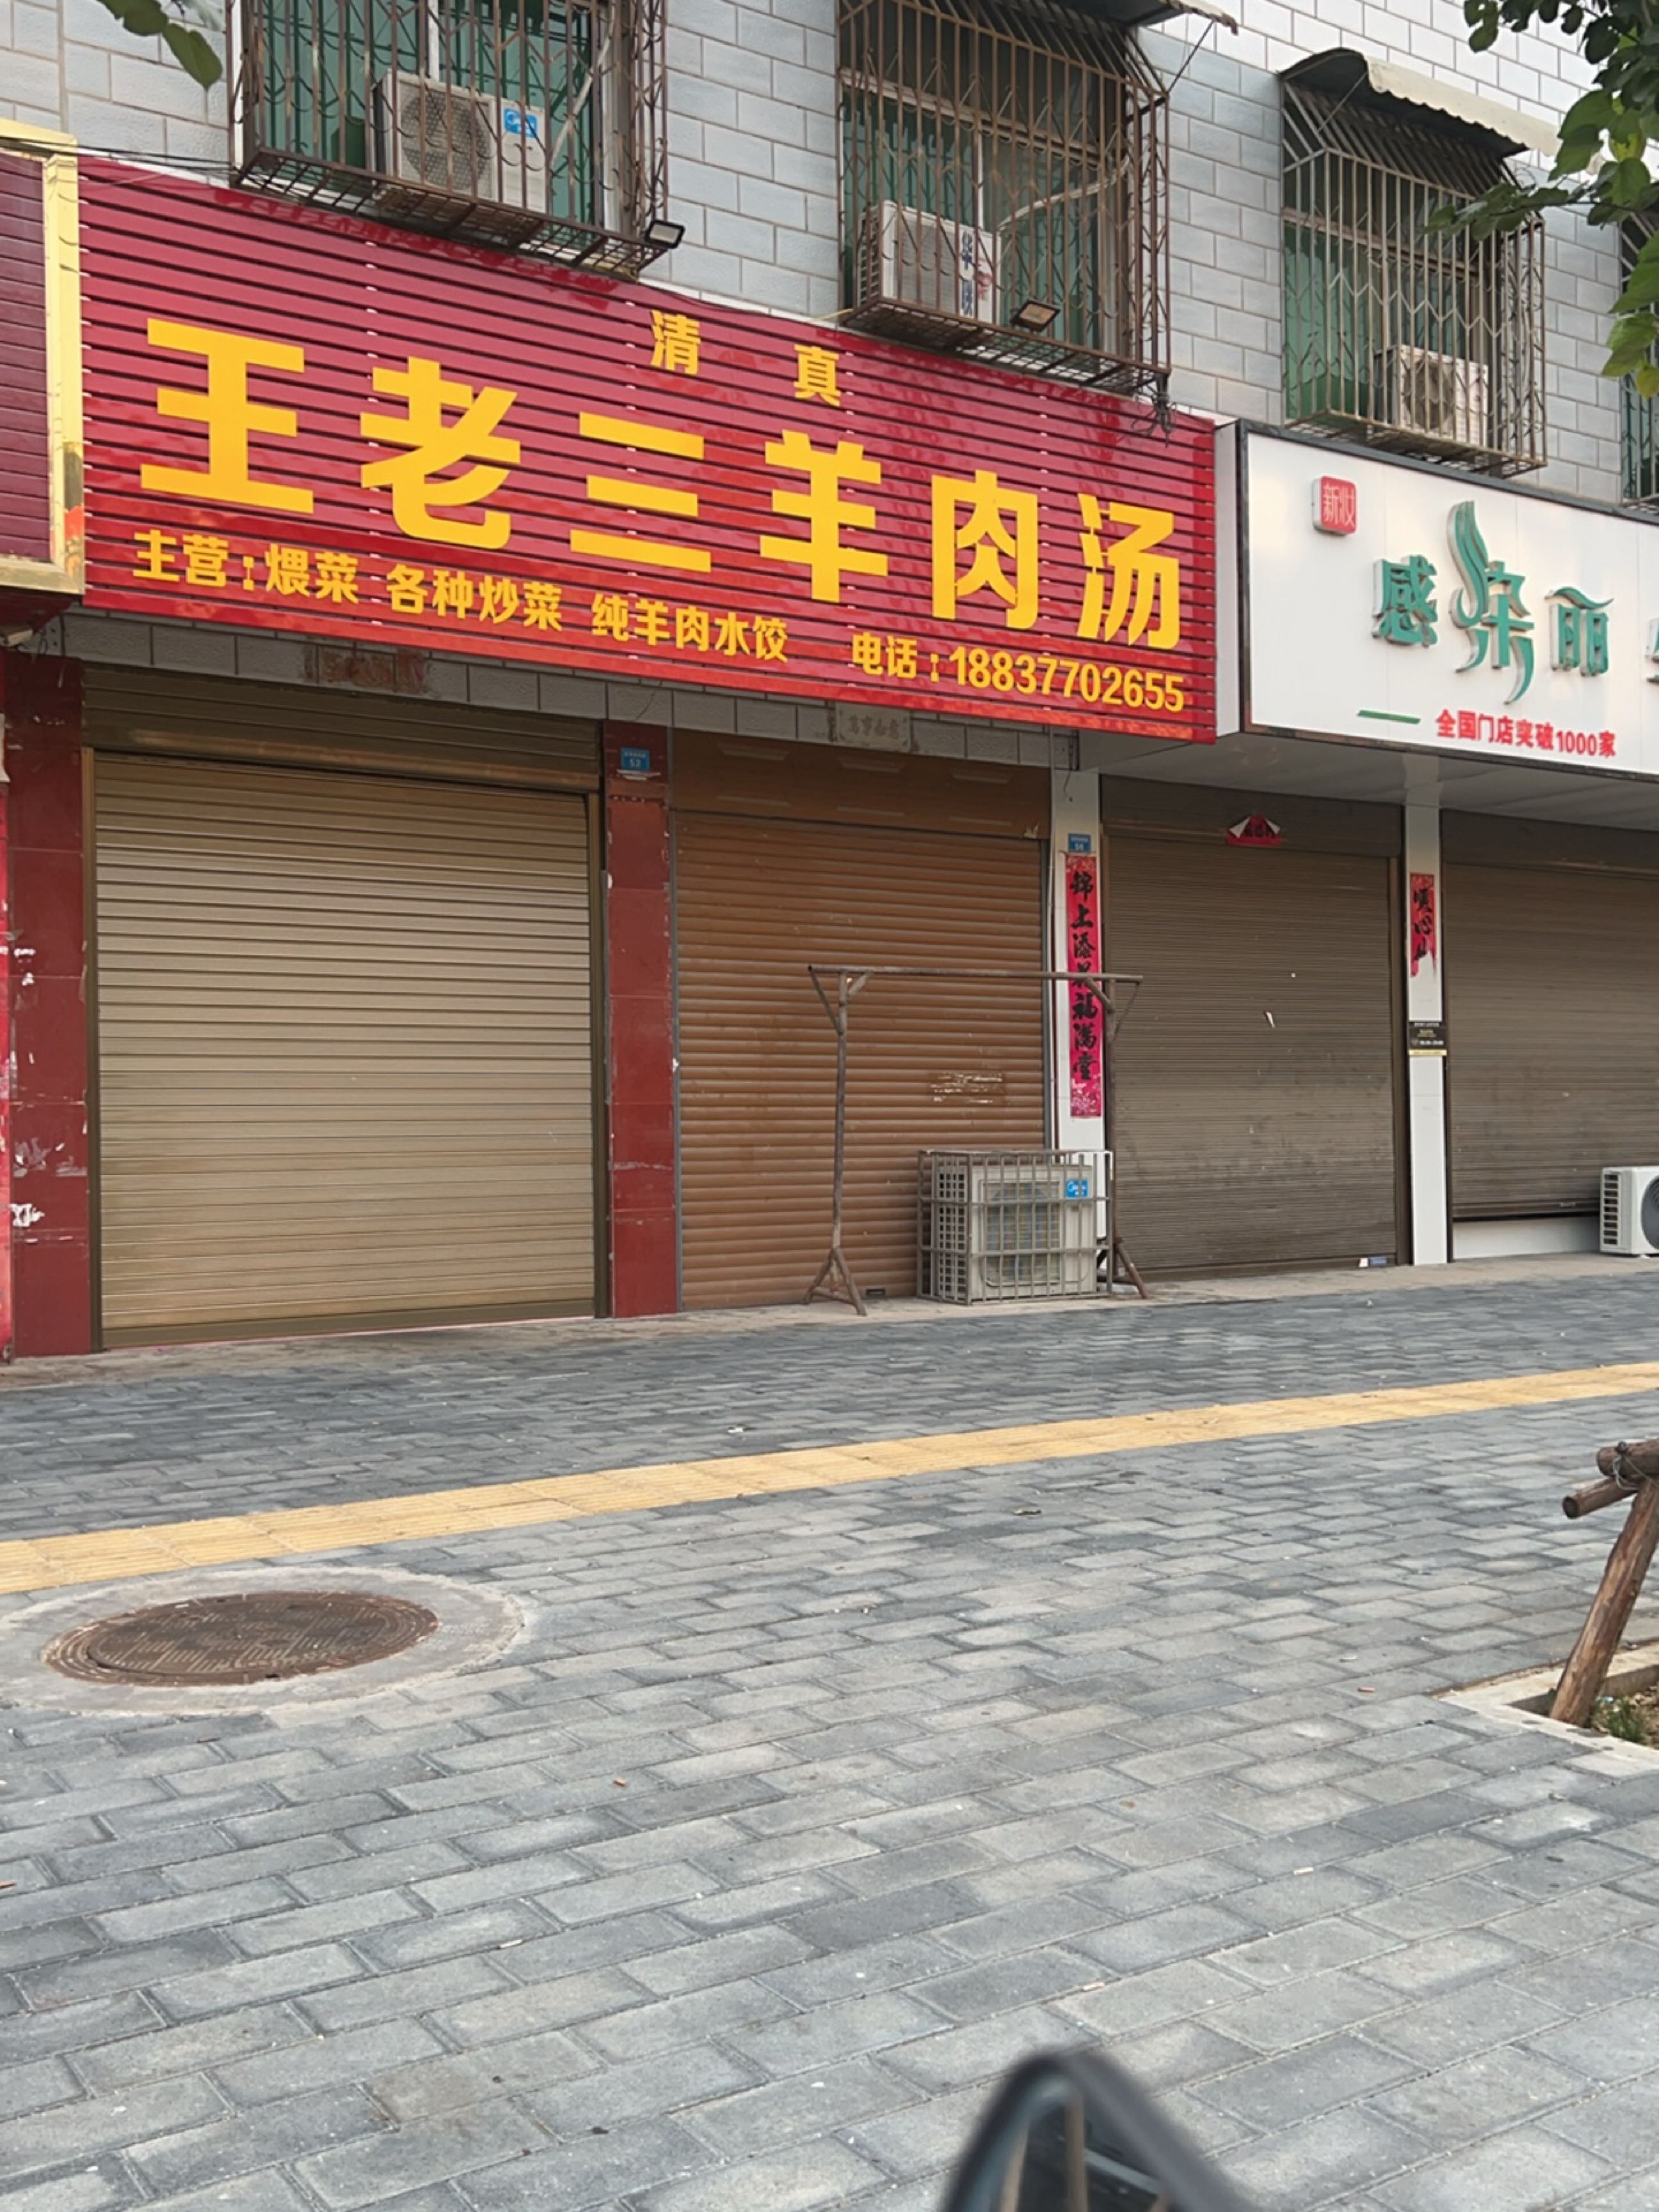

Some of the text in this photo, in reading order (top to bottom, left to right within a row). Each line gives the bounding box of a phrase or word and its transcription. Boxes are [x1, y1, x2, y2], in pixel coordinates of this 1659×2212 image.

[650, 309, 841, 406] 清真
[140, 318, 1181, 650] 王老三羊肉汤
[387, 563, 563, 631] 各种炒菜
[591, 593, 788, 662] 纯羊肉水饺
[1373, 500, 1659, 705] 感染丽
[1436, 709, 1617, 757] 全国门店突破1000家
